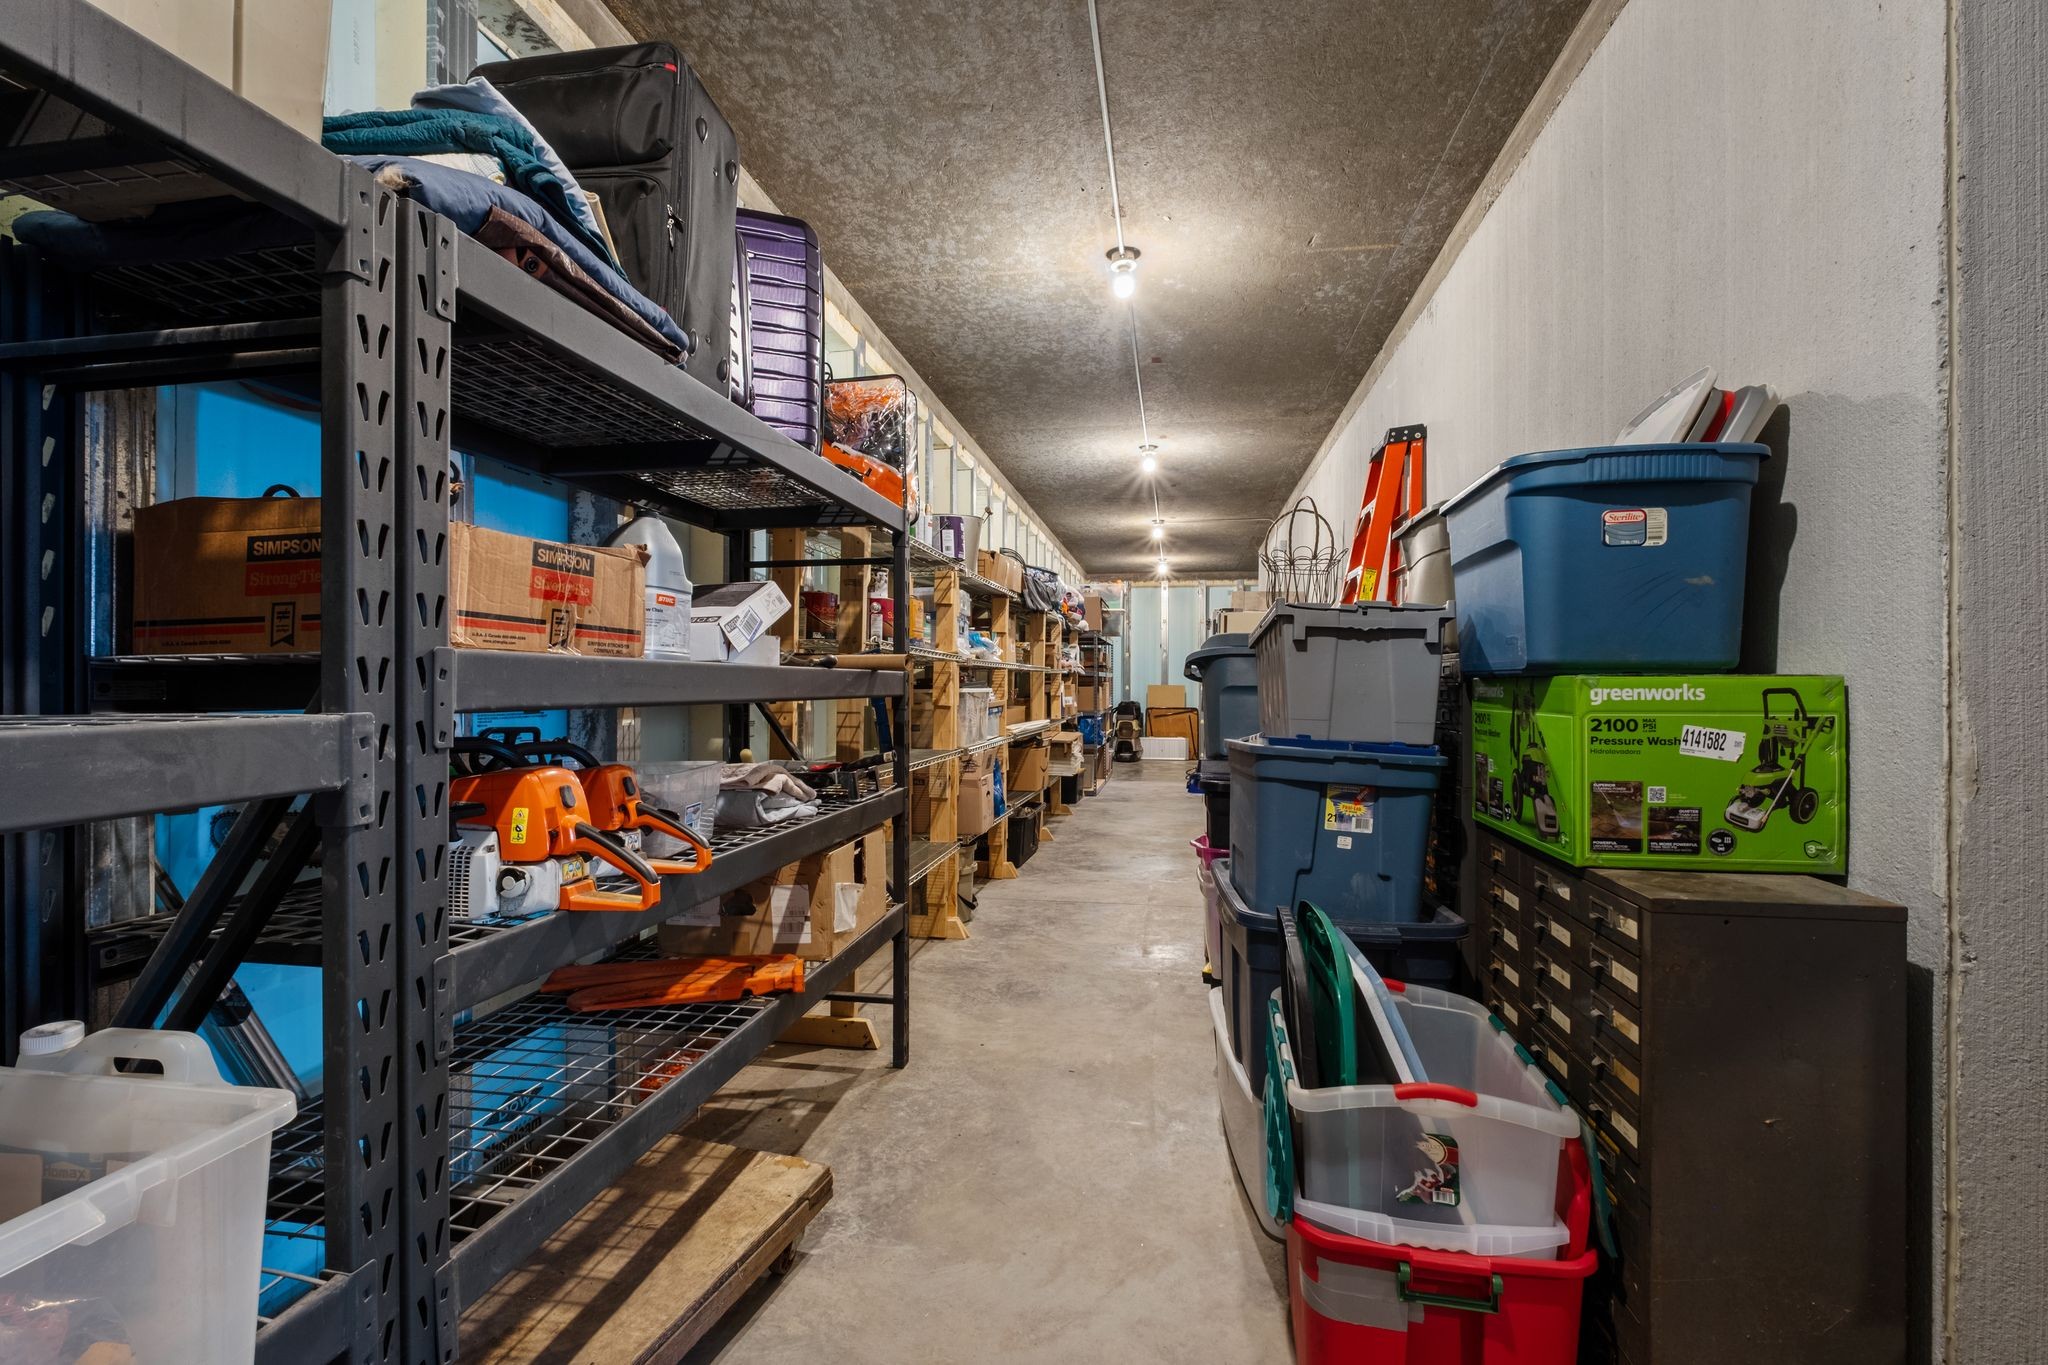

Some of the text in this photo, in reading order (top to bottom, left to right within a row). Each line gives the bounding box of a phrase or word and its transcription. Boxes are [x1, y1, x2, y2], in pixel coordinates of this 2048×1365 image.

[1608, 512, 1639, 521] Sterilite
[253, 538, 321, 556] SIMPSON
[537, 548, 591, 571] SIMPSON
[657, 596, 674, 604] STIHL
[1590, 683, 1706, 705] greenworks
[1590, 718, 1639, 732] 2100
[1590, 736, 1681, 746] Pressure Wash
[1682, 728, 1727, 751] 4141582
[1327, 812, 1337, 823] 21
[1807, 845, 1816, 854] 3
